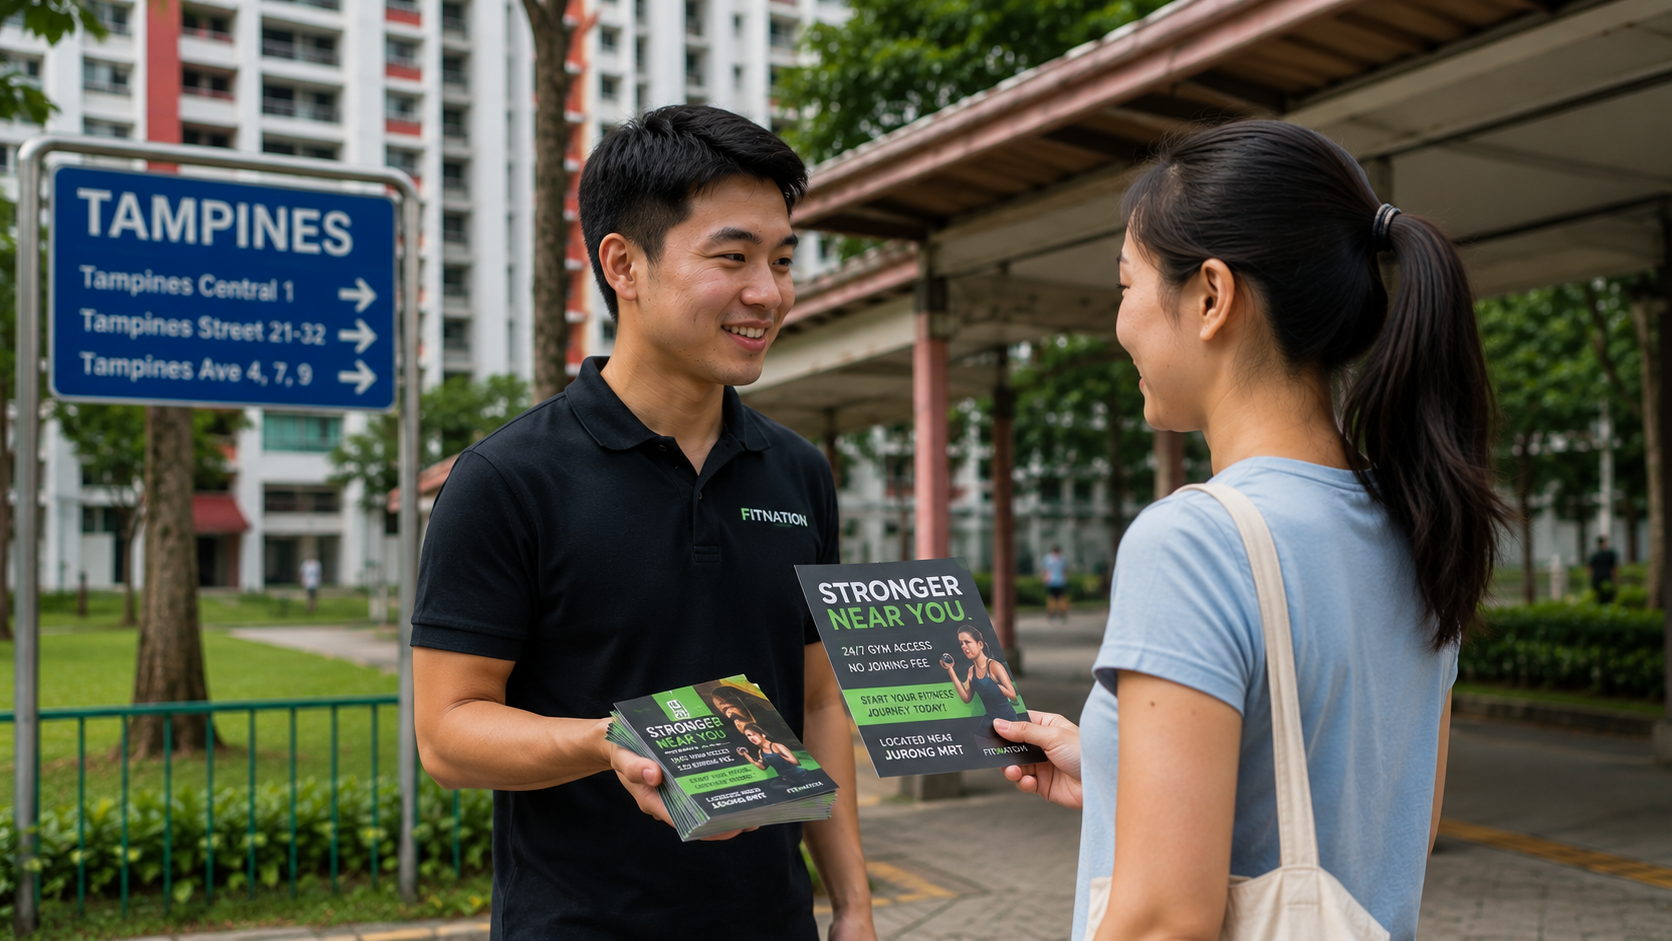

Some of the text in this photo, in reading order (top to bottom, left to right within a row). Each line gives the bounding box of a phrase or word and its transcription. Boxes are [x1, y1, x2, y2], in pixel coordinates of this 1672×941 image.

[77, 187, 353, 257] TAMPINES
[79, 265, 294, 303] Tampines Central 1
[79, 308, 327, 346] Tampines Street 21-32
[79, 351, 313, 388] Tampines Ave 4, 7, 9
[741, 507, 808, 527] FITNATION
[818, 575, 963, 604] STRONGER
[827, 600, 973, 631] NEAR YOU.
[841, 640, 933, 656] 24/7 GYM ACCESS
[848, 663, 865, 673] NO
[910, 658, 930, 668] FEE
[891, 692, 917, 704] YOUR
[913, 703, 947, 714] TODAY!
[655, 734, 697, 749] NEAR
[697, 729, 727, 741] YOU
[879, 735, 926, 747] LOCATED
[885, 744, 964, 760] JURONG MRT
